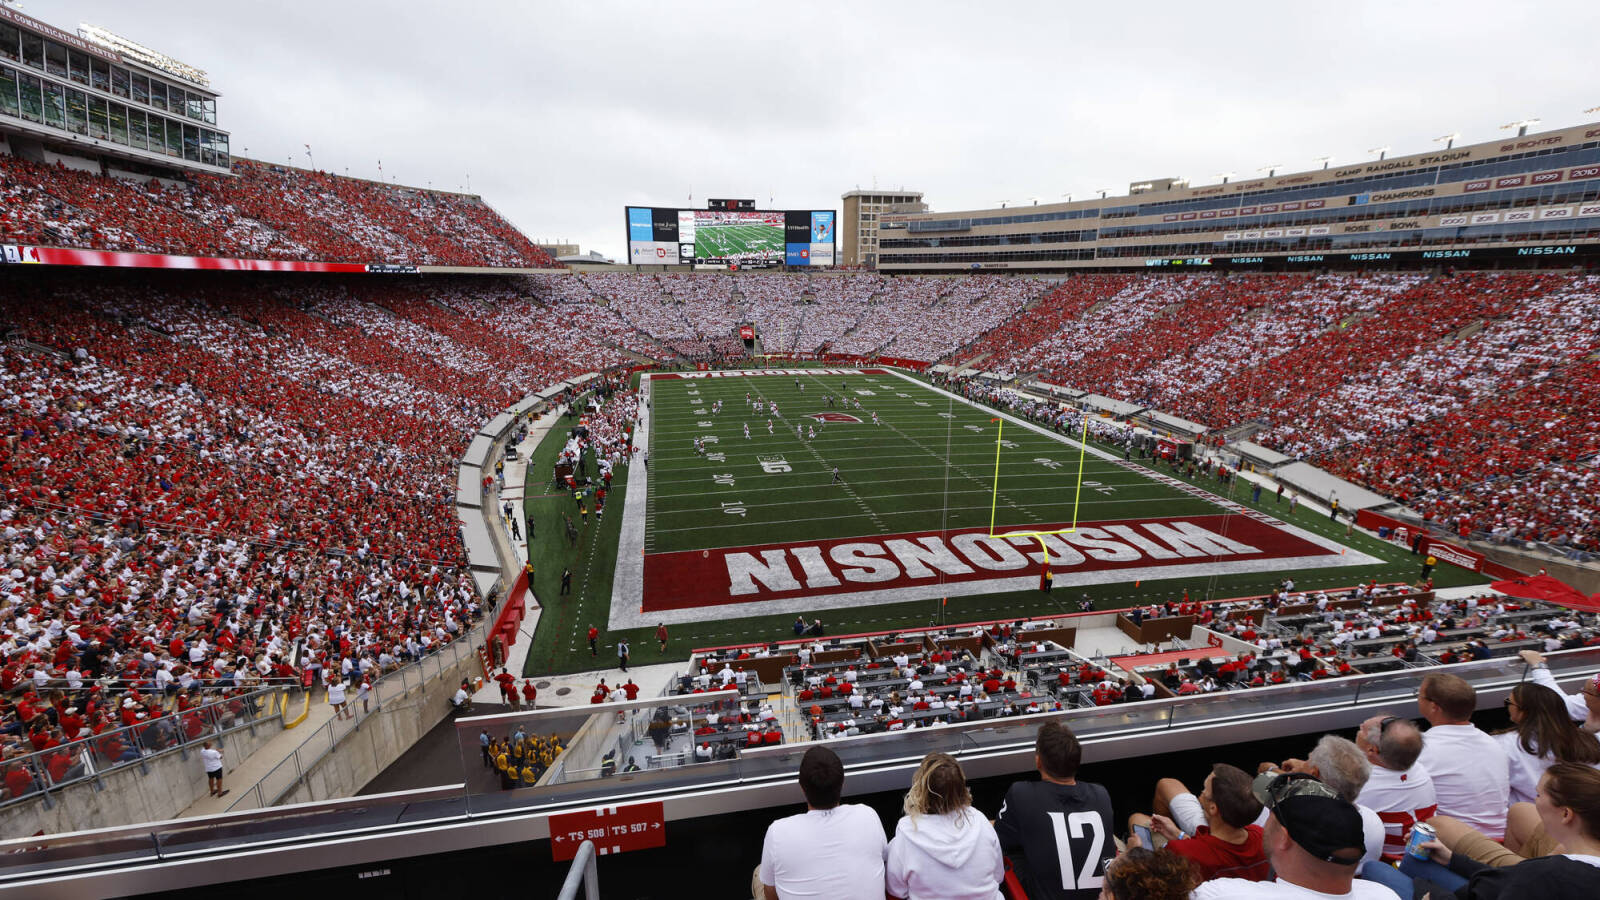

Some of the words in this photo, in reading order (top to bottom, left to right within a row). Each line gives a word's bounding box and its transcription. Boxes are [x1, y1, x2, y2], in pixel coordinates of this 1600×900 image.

[14, 13, 87, 48] COMMUNICATIONS
[88, 44, 118, 61] CENTER
[1517, 136, 1562, 150] RICHTER
[1335, 168, 1362, 178] CAMP
[1366, 161, 1414, 173] RANDALL
[1419, 151, 1471, 166] STADIUM
[1535, 173, 1559, 182] 1999
[1571, 168, 1598, 178] 2010
[1499, 177, 1521, 186] 1998
[1372, 188, 1435, 202] CHAMPIONS
[1508, 212, 1530, 220] 2012
[1390, 220, 1421, 230] BOWL
[1423, 250, 1471, 259] NISSAN
[1516, 246, 1577, 256] NISSAN
[1350, 253, 1392, 261] NISSAN
[675, 369, 865, 379] WISCONSIN
[721, 501, 747, 514] 10
[724, 520, 1262, 596] WISCONSIN
[612, 825, 628, 835] TS
[630, 822, 648, 833] 507
[568, 831, 585, 841] TS
[587, 828, 605, 839] 508
[1046, 810, 1105, 890] 12
